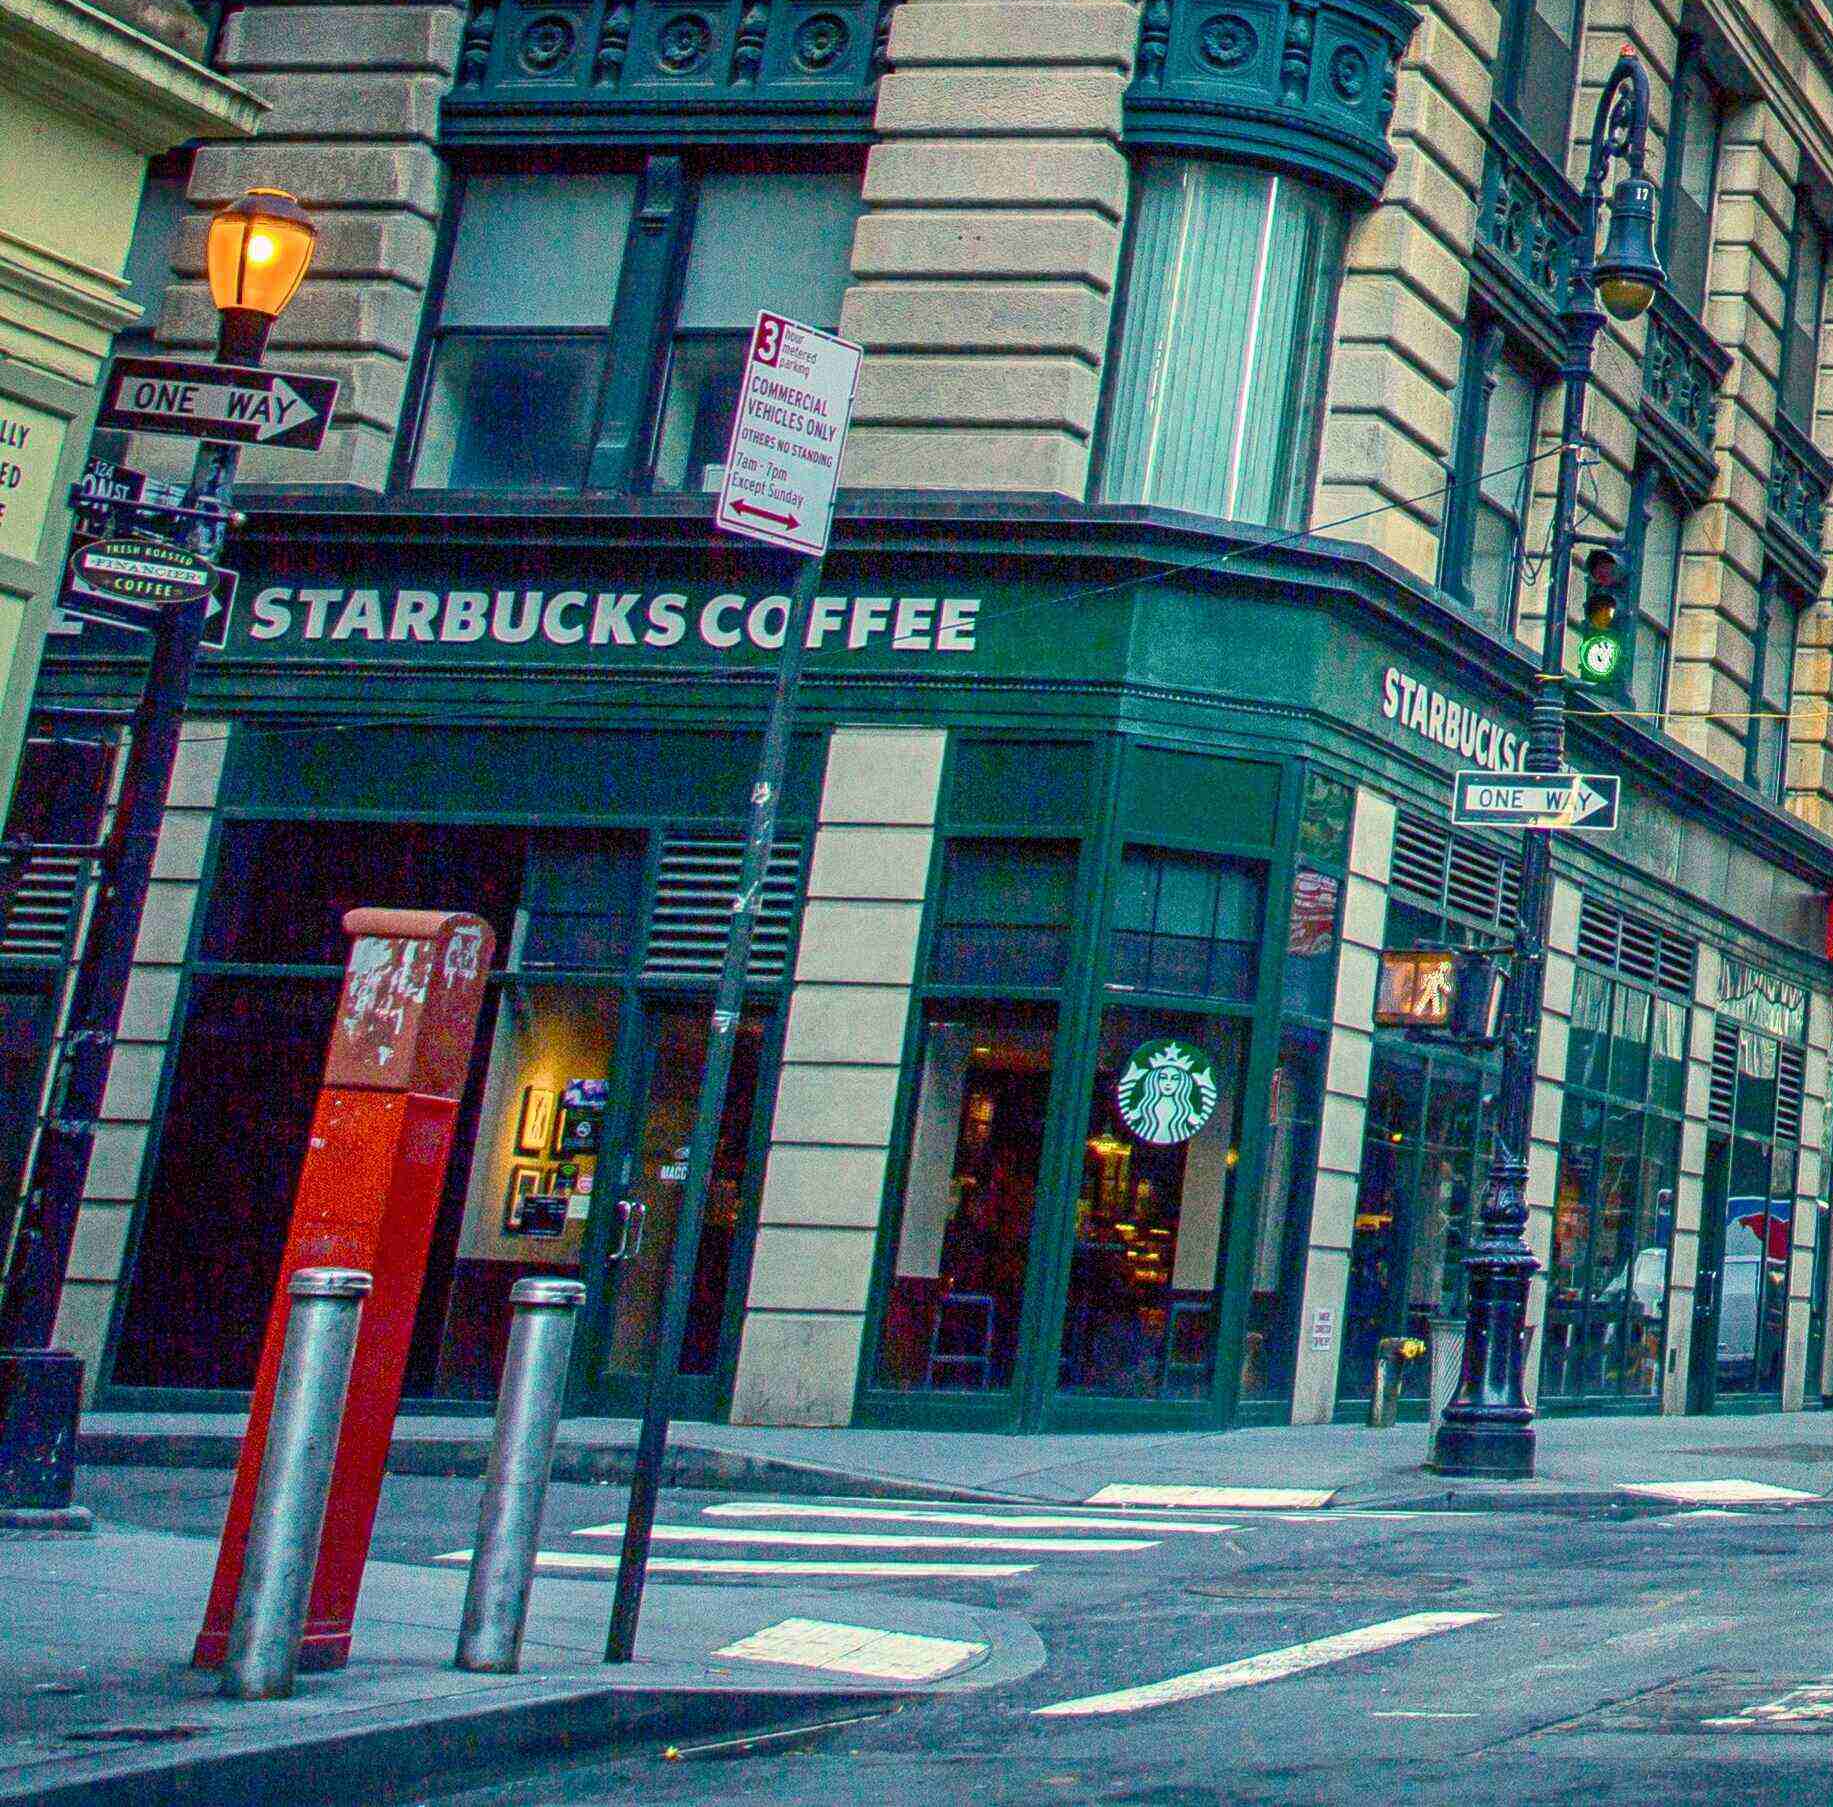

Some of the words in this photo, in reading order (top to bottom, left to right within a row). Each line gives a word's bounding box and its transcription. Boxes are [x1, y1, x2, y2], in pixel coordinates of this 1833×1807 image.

[1636, 187, 1649, 201] 17
[757, 320, 779, 362] 3
[782, 342, 818, 366] metered
[784, 328, 806, 345] hour
[778, 357, 811, 380] parking
[133, 382, 199, 413] ONE
[228, 391, 297, 425] WAY
[751, 375, 828, 417] COMMERCIAL
[748, 398, 804, 433] VEHICLES
[806, 416, 837, 443] ONLY
[736, 450, 758, 472] 7am
[765, 461, 788, 483] 7pm
[741, 426, 776, 454] OTHERS
[777, 438, 791, 455] NO
[791, 444, 834, 469] STANDING
[731, 471, 767, 498] Except
[767, 482, 805, 510] Sunday
[114, 577, 173, 597] COFFEE
[250, 588, 687, 649] STARBUCKS
[700, 594, 981, 650] COFFEE
[1382, 666, 1516, 773] STARBUCKS
[1479, 788, 1524, 809] ONE
